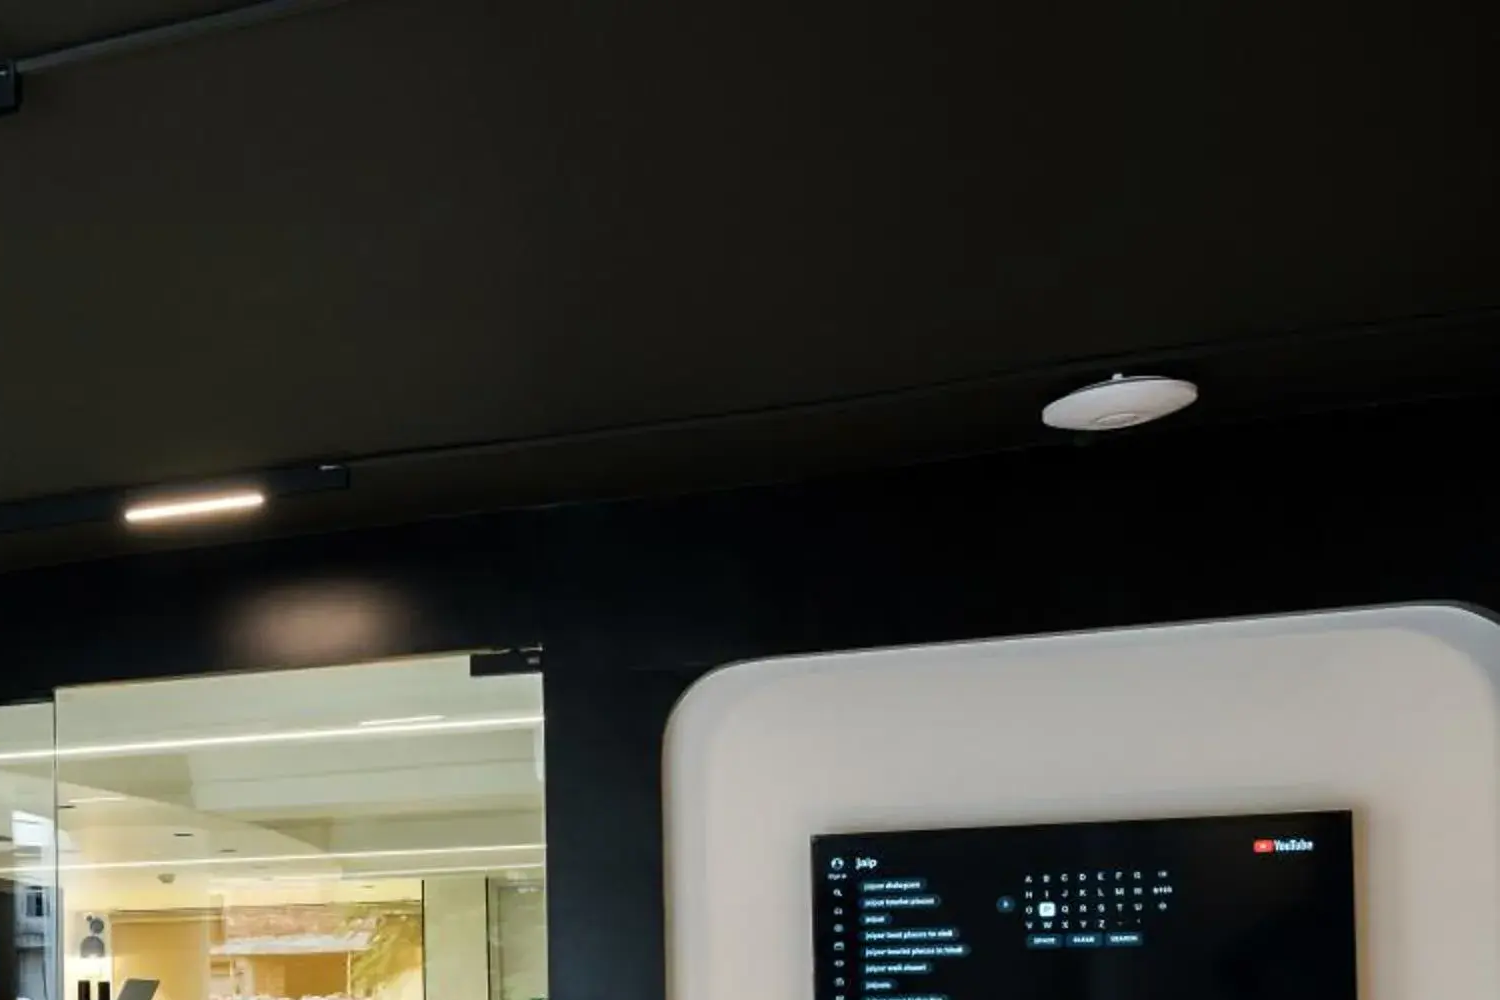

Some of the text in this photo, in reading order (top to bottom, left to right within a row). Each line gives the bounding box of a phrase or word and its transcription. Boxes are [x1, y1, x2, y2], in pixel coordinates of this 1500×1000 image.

[1274, 838, 1313, 851] YouTube
[1024, 875, 1033, 884] A
[1079, 873, 1087, 881] D
[1025, 891, 1033, 899] H
[1079, 888, 1087, 897] K
[1115, 887, 1125, 896] M
[1098, 919, 1105, 929] Z
